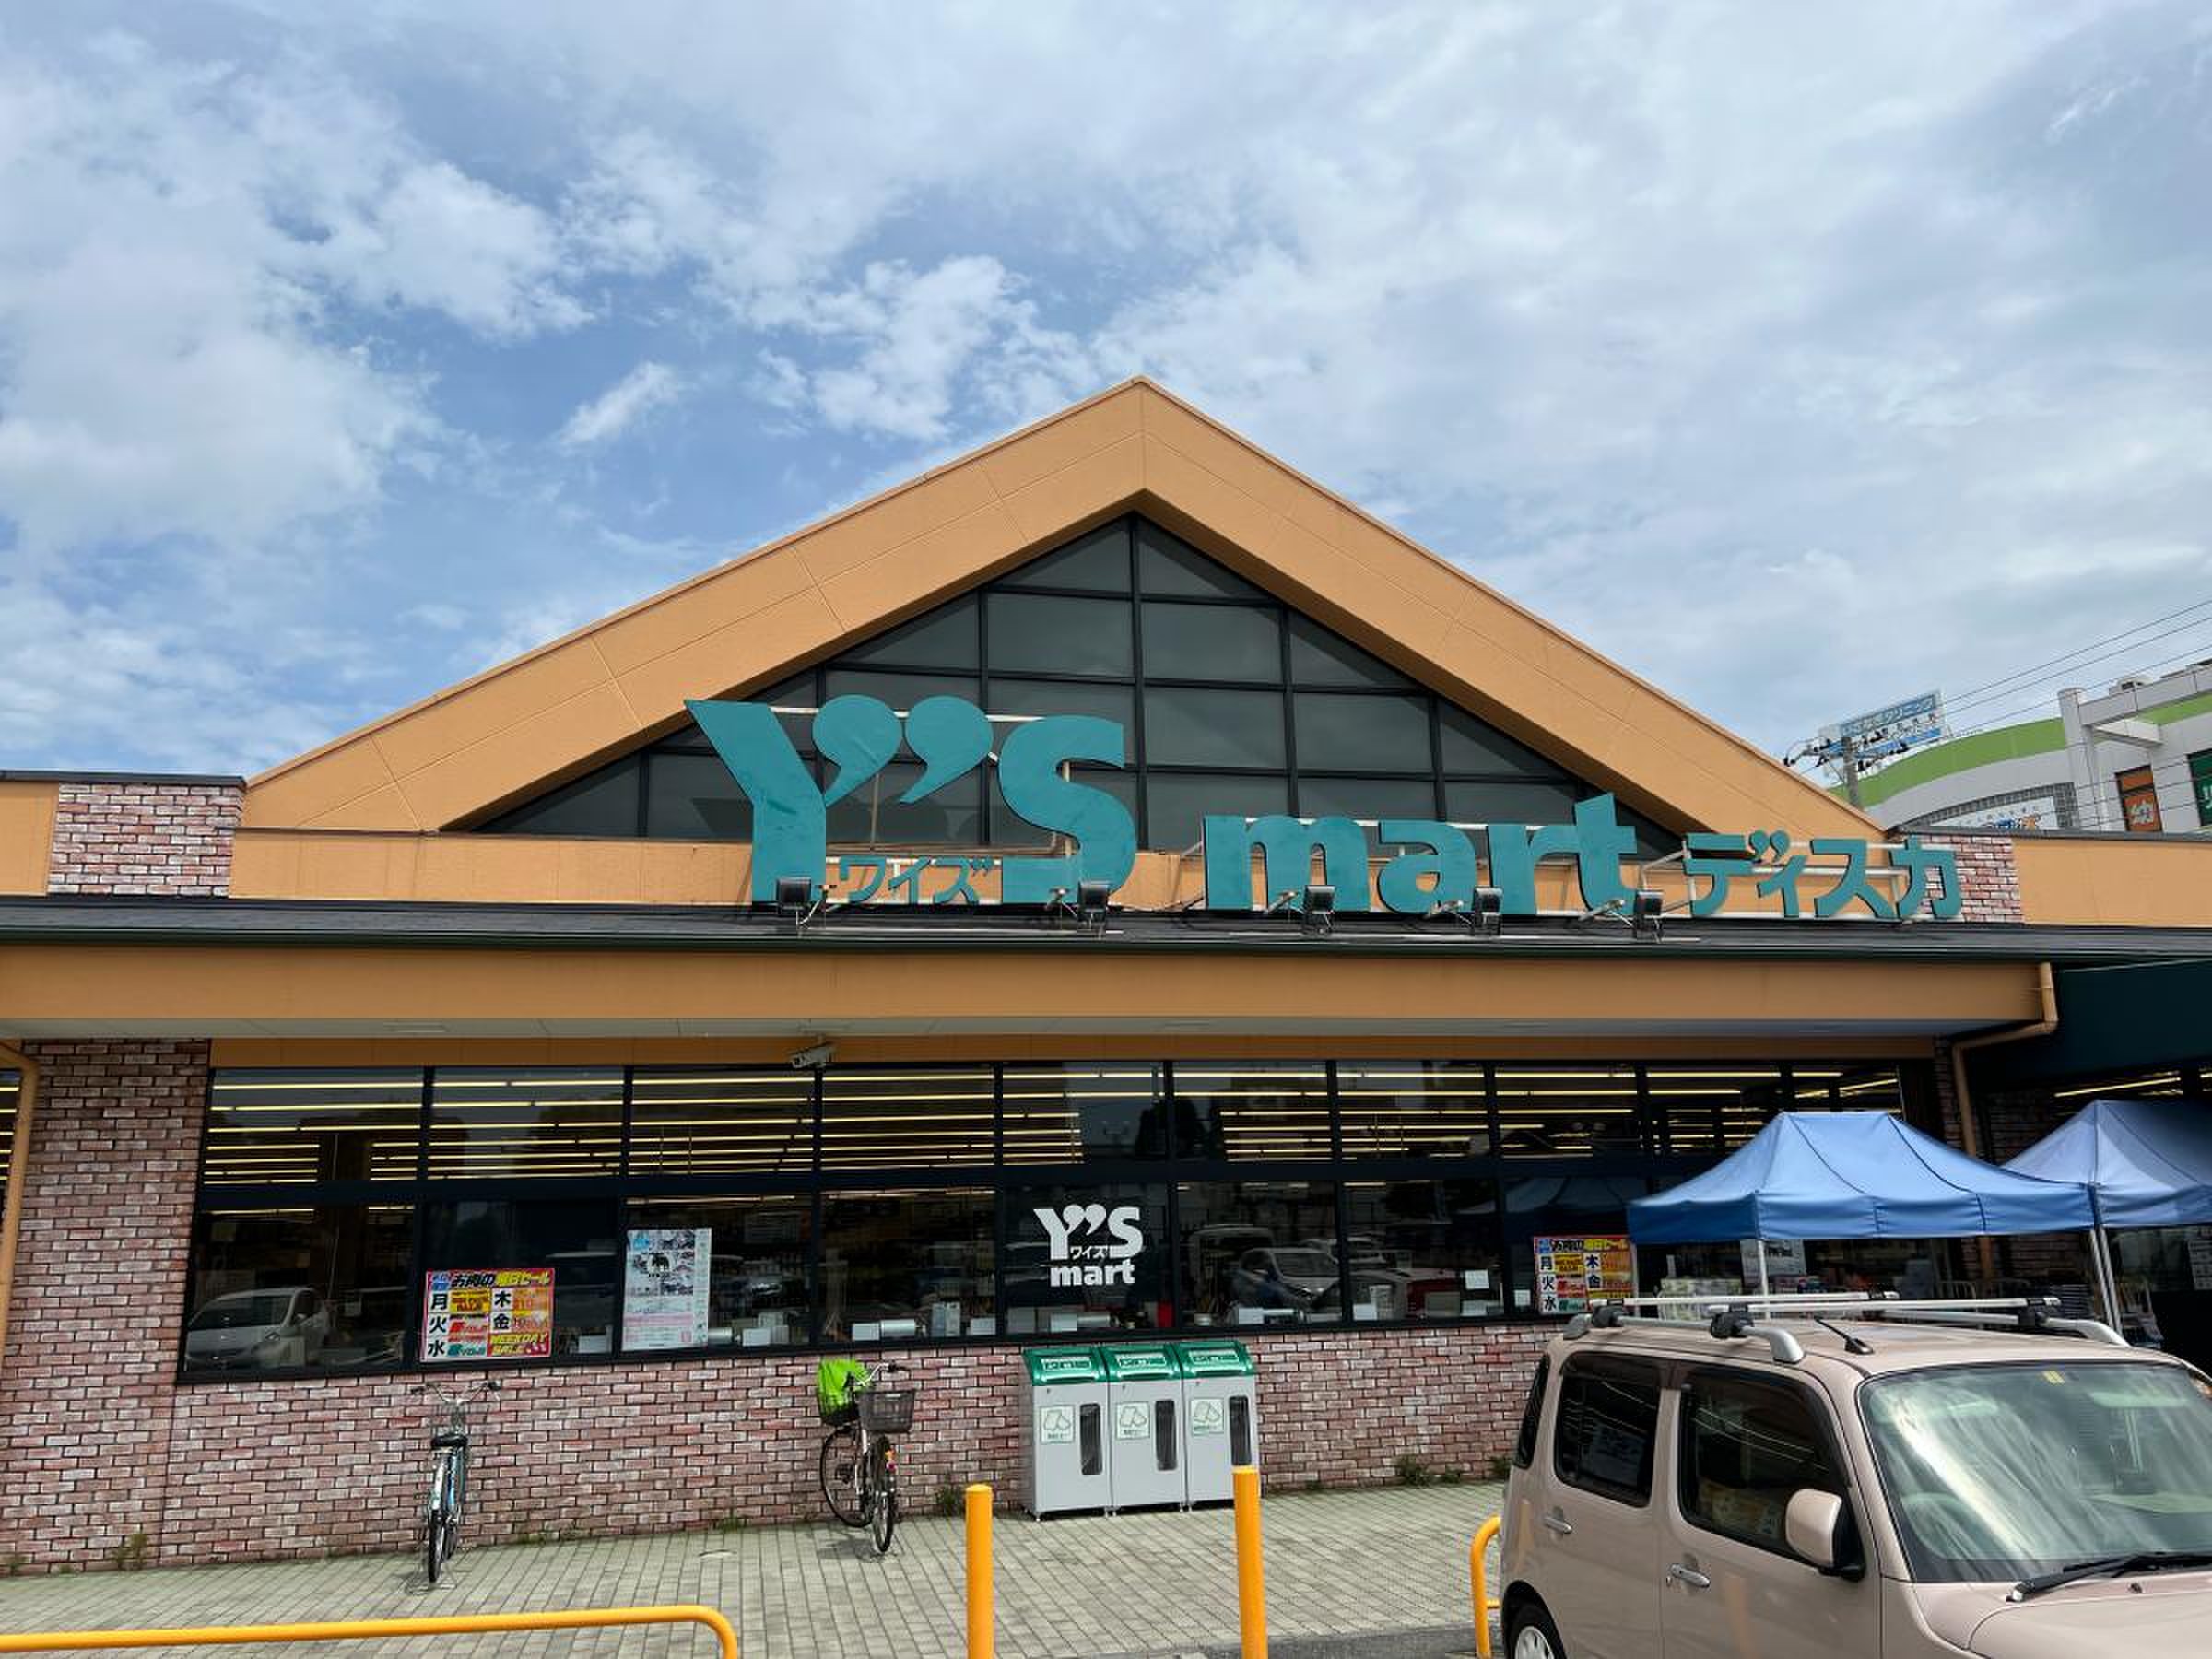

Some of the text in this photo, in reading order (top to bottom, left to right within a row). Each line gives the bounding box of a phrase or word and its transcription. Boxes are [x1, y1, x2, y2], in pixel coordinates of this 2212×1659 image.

[1203, 793, 1638, 915] mart
[840, 856, 994, 904] ワイズ
[1684, 830, 1962, 920] ディスカ
[1070, 1246, 1108, 1259] ワイズ
[1585, 1254, 1599, 1268] 木
[1051, 1259, 1135, 1287] mart
[1542, 1276, 1556, 1290] 火
[430, 1293, 448, 1310] 月
[494, 1290, 511, 1308] 木
[429, 1316, 446, 1333] 火
[493, 1313, 510, 1330] 金
[428, 1340, 445, 1357] 水
